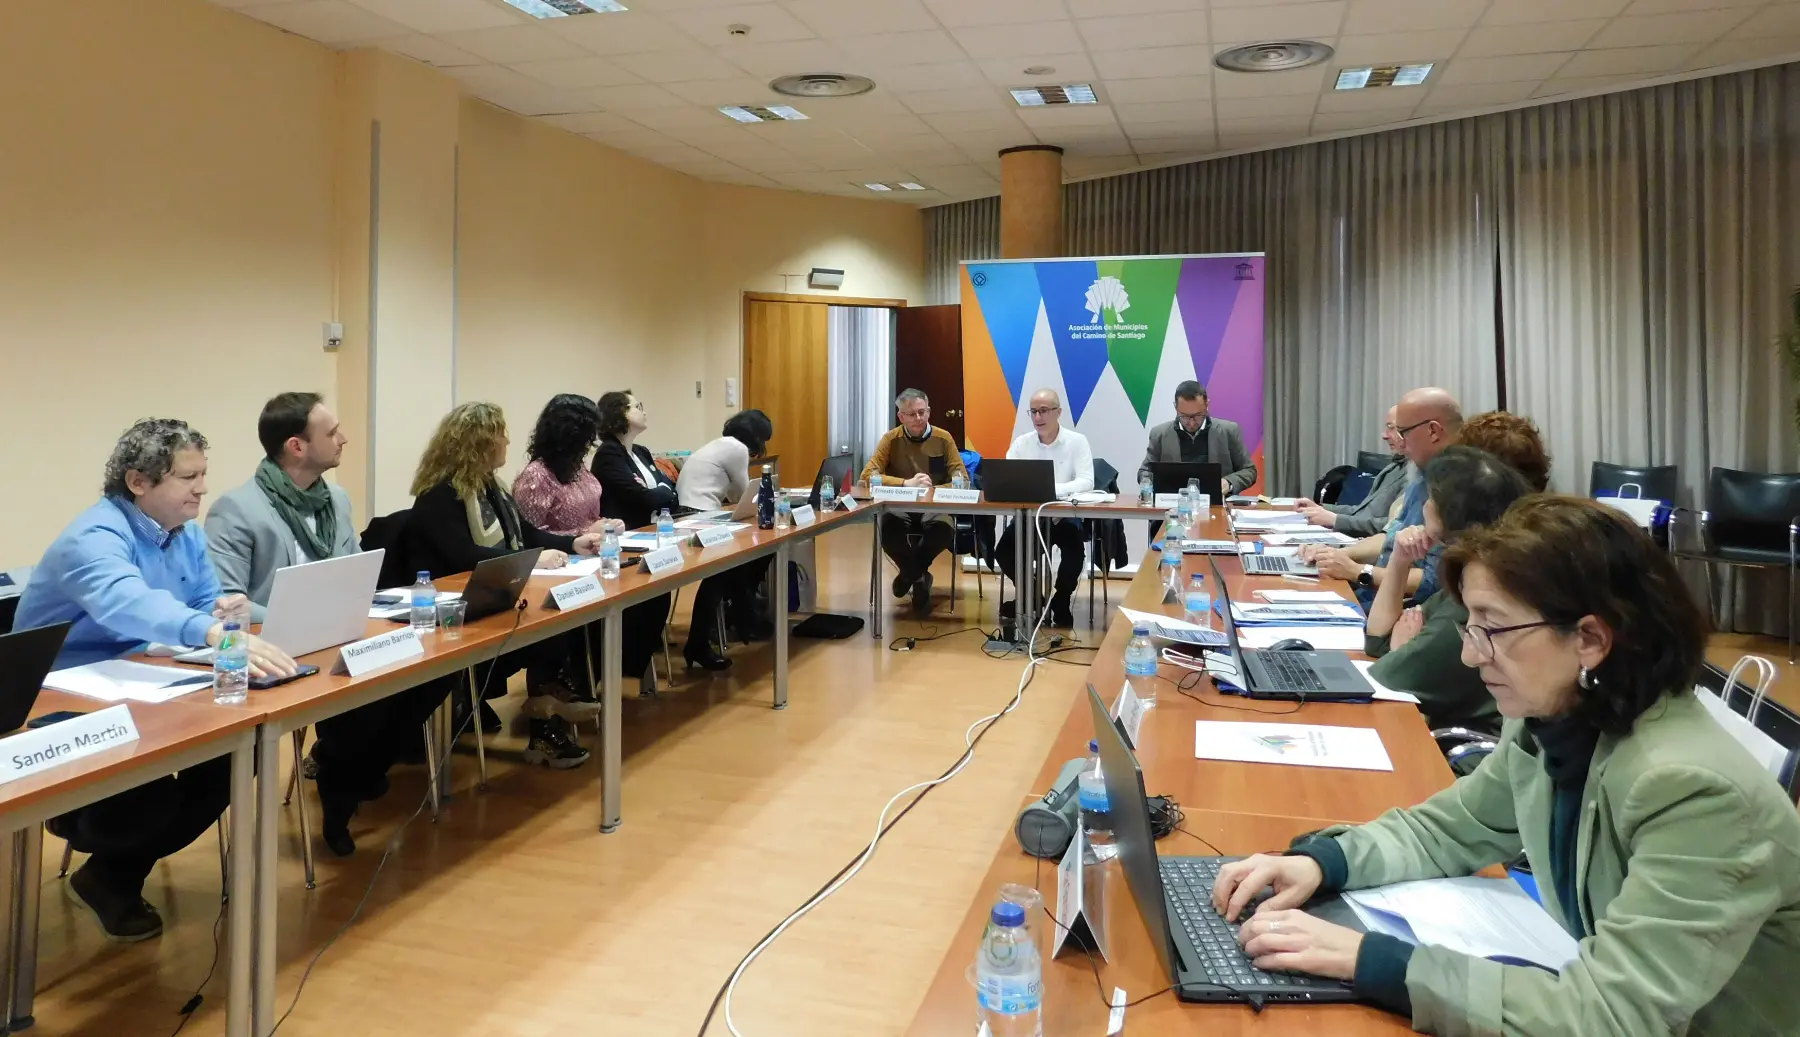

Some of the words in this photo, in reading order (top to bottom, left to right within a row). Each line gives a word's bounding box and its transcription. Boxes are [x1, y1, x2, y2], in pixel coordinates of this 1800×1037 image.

[1117, 332, 1146, 340] Santiago
[556, 588, 575, 601] Daniel
[347, 639, 391, 658] Maximiliano
[391, 631, 415, 644] Barrios
[12, 744, 72, 770] Sandra
[74, 723, 129, 749] Martín
